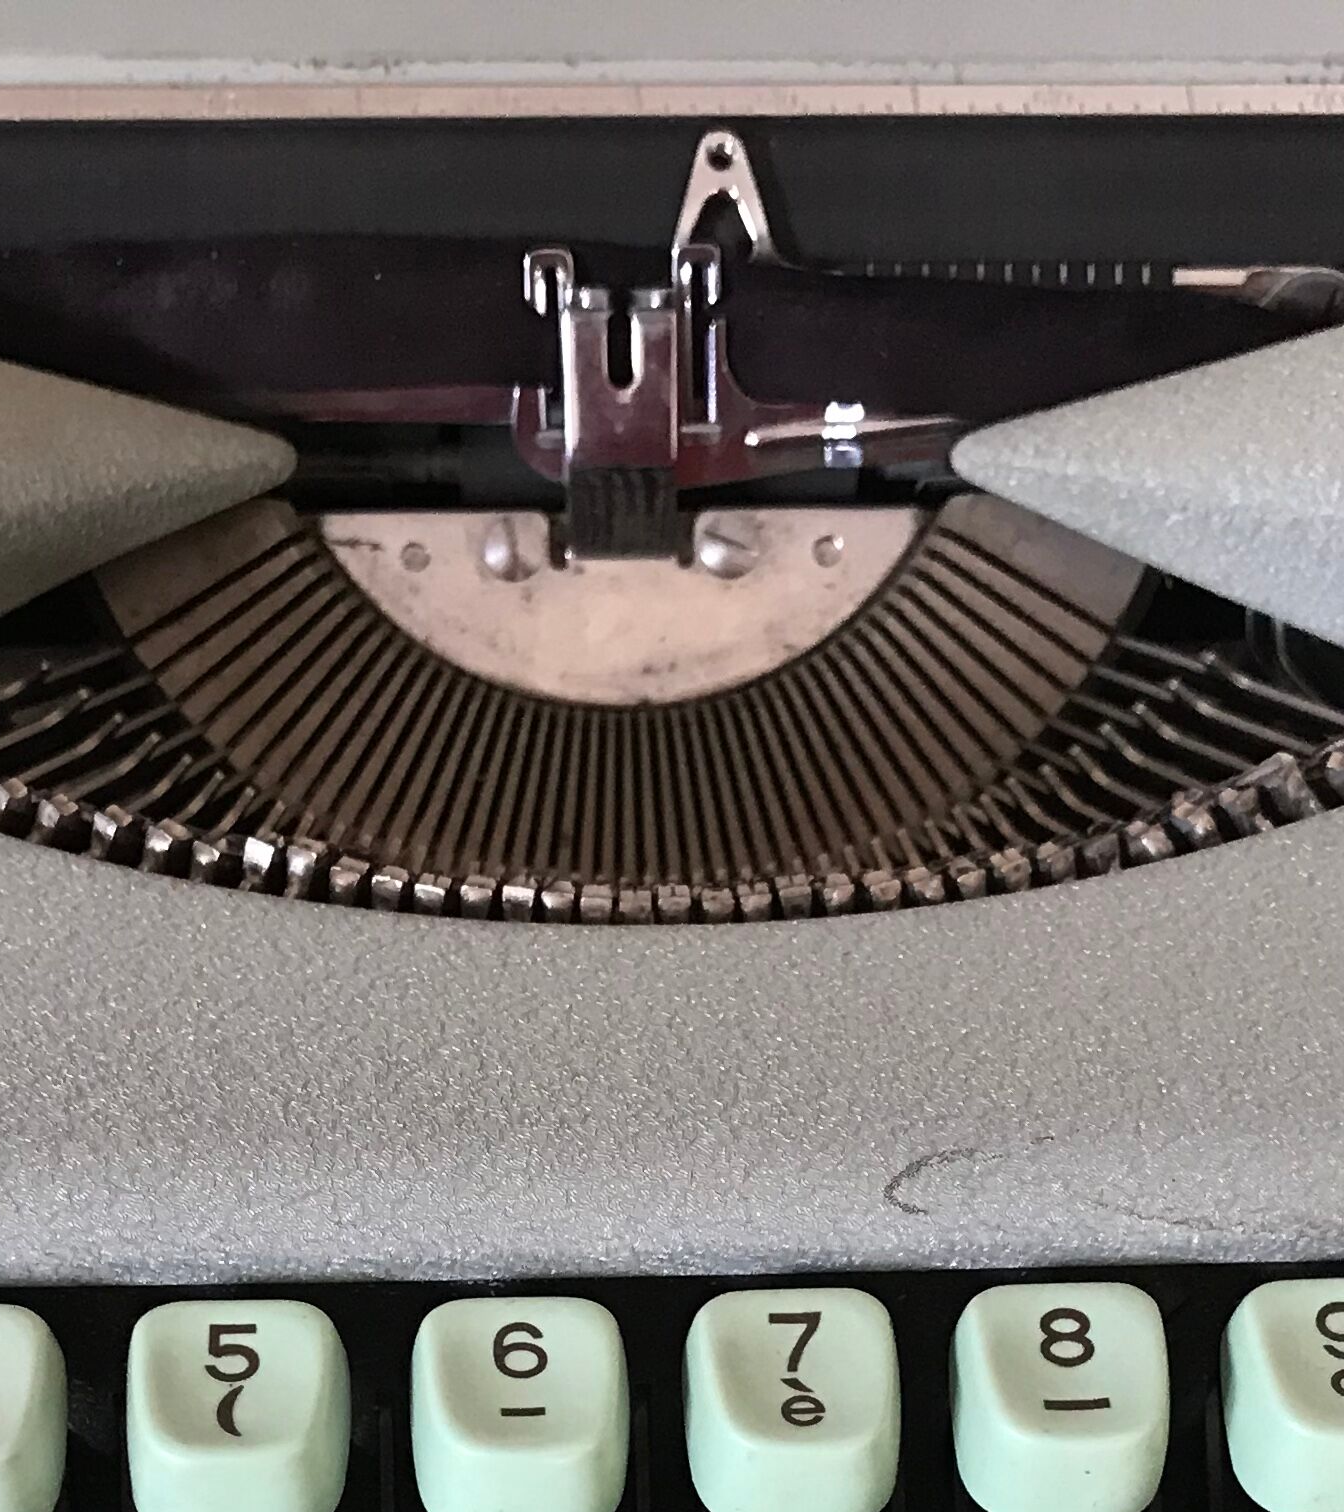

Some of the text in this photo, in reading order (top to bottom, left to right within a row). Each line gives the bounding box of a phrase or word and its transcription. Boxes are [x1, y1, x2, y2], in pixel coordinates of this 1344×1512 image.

[204, 1323, 261, 1383] 5
[492, 1321, 548, 1380] 6
[768, 1311, 822, 1373] 7
[1039, 1307, 1095, 1368] 8
[780, 1377, 826, 1428] è
